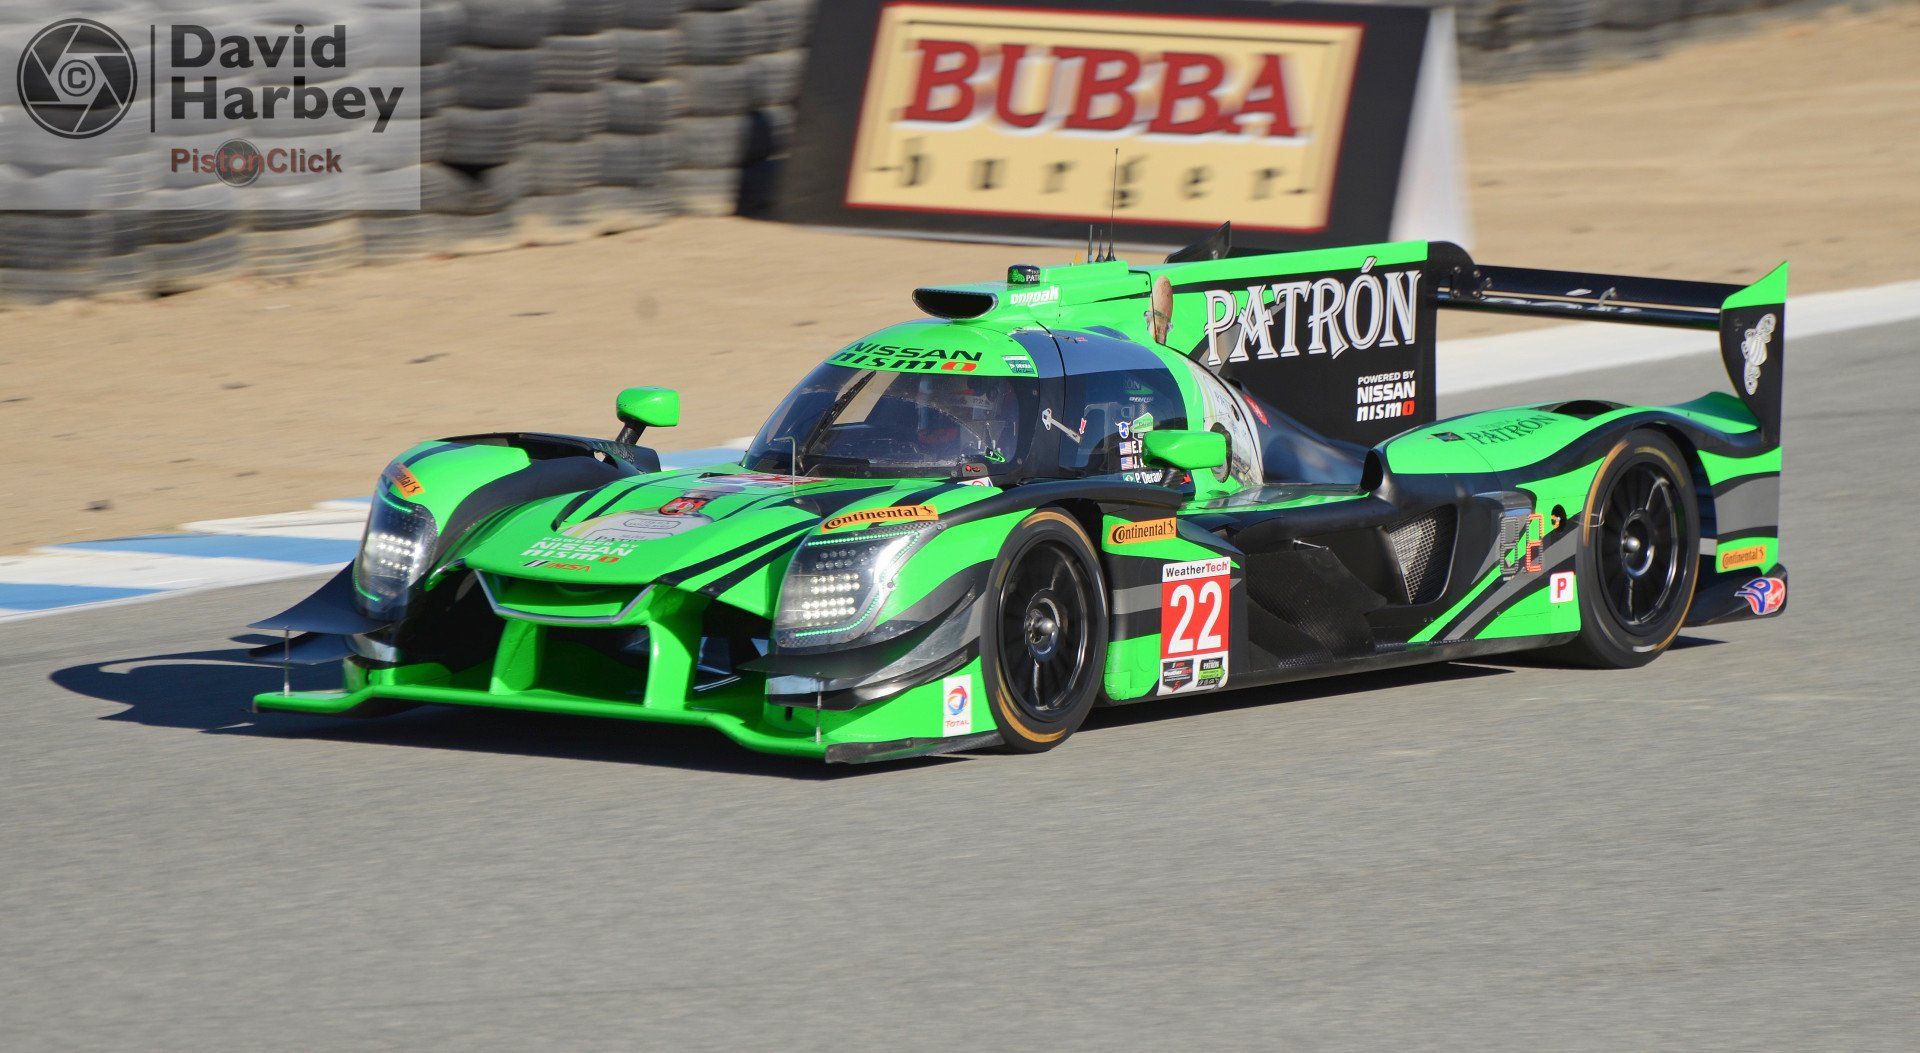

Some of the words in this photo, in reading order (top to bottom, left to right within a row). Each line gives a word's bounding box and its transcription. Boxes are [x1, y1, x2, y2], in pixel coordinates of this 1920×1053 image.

[902, 38, 1304, 141] BUBBA
[1203, 256, 1423, 366] PATRÓN
[831, 352, 977, 373] nismo
[848, 342, 982, 361] NISSAN
[1357, 371, 1401, 385] POWERED
[1402, 370, 1415, 380] BY
[1356, 380, 1416, 405] NISSAN
[1356, 400, 1415, 422] nismo
[823, 506, 921, 531] Continental
[1111, 521, 1166, 544] Continental
[519, 549, 620, 564] nismo
[530, 541, 635, 557] NISSAN
[1165, 561, 1230, 578] WeatherTech
[1556, 577, 1567, 599] P
[1167, 580, 1223, 655] 22
[945, 720, 970, 728] TOTAL
